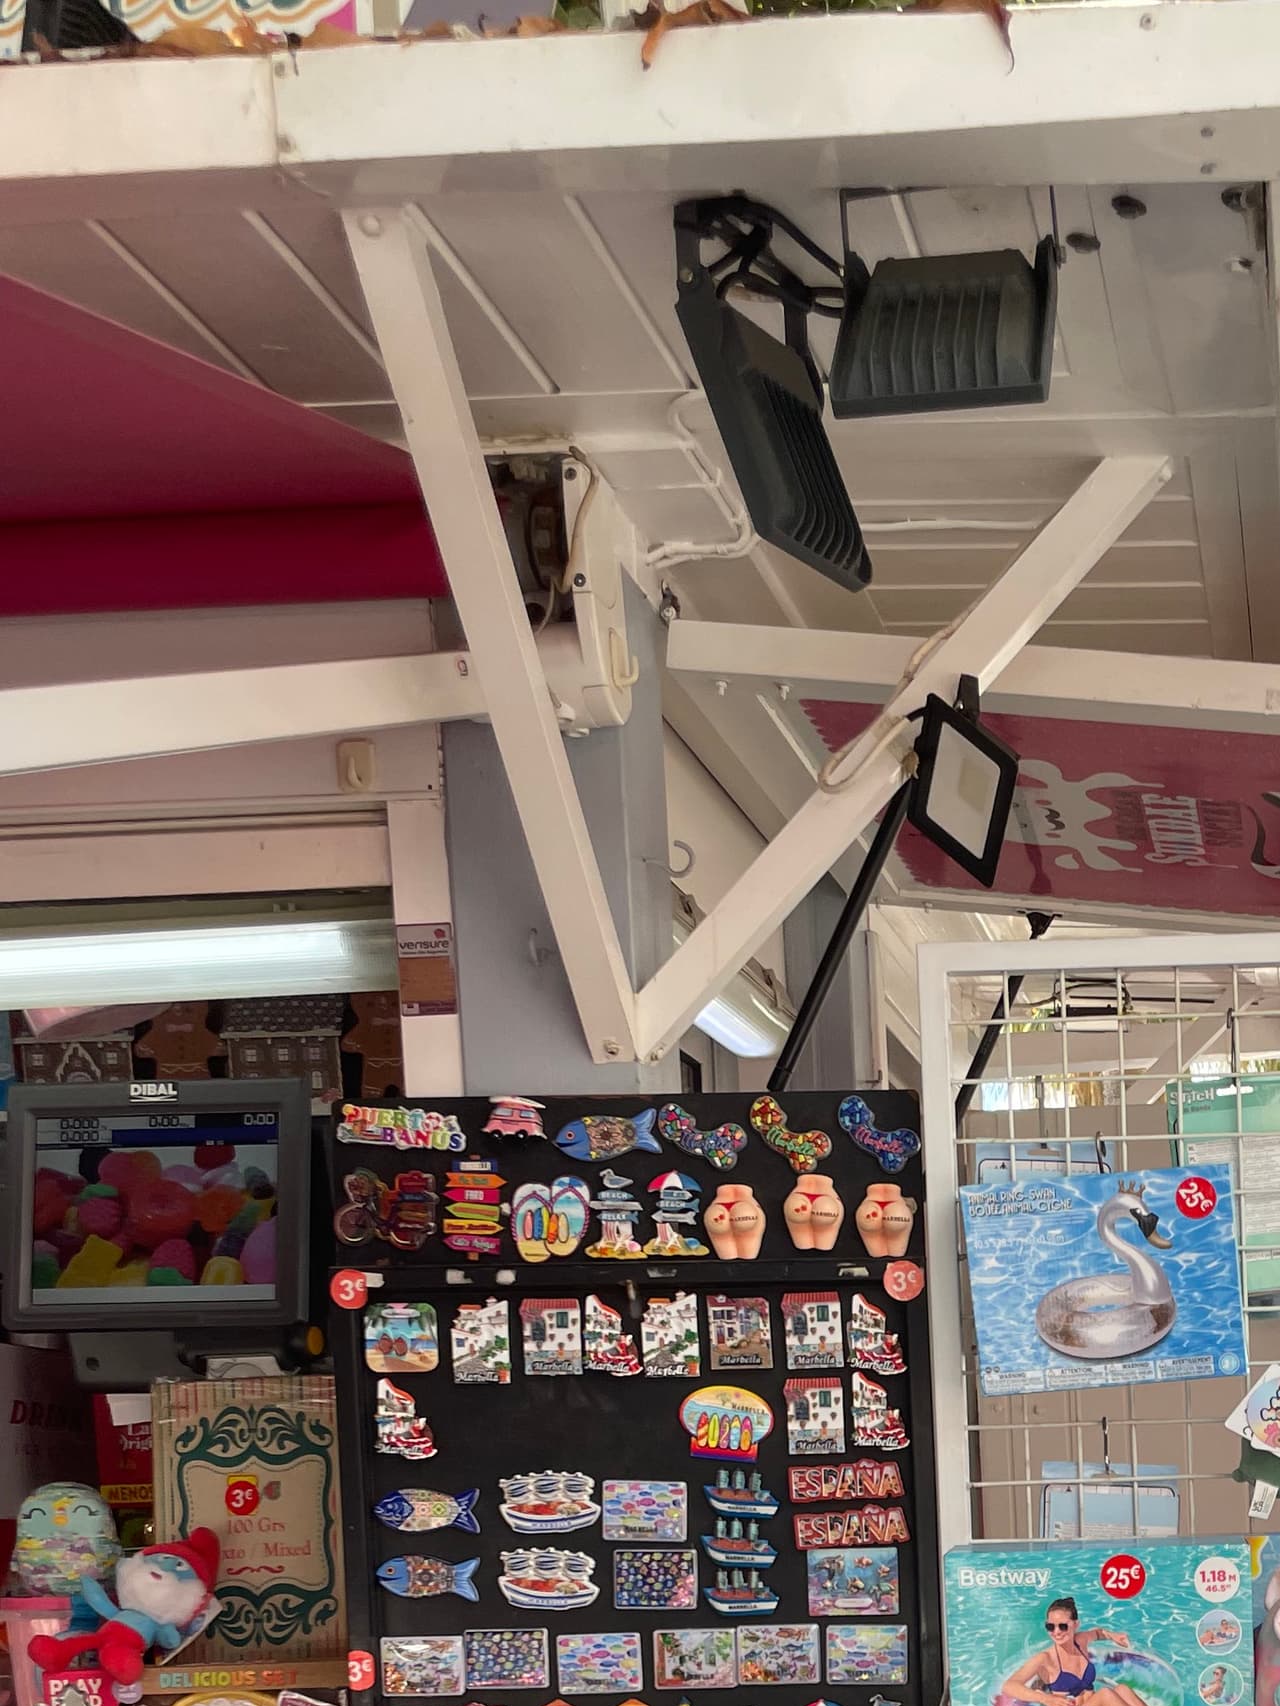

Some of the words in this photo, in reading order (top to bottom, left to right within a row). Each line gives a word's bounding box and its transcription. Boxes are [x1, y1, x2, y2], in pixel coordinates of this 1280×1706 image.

[129, 1083, 178, 1097] DIBAL
[344, 1103, 443, 1131] PUERTO
[1029, 1188, 1057, 1200] SWAN
[1178, 1182, 1214, 1212] 25€
[339, 1278, 366, 1302] 3€
[892, 1270, 918, 1291] 3€
[849, 1358, 896, 1371] Marbella
[854, 1434, 899, 1447] Marbella
[792, 1461, 904, 1500] ESPAÑA
[231, 1488, 254, 1508] 3€
[258, 1518, 286, 1533] Grs
[797, 1507, 910, 1547] ESPAÑA
[264, 1542, 312, 1558] Mixed
[960, 1567, 1049, 1588] Bestway
[1105, 1564, 1141, 1590] 25€
[1200, 1569, 1227, 1584] 1.18
[159, 1671, 257, 1689] DELICIOUS
[261, 1670, 297, 1687] SET
[348, 1660, 373, 1682] 3€
